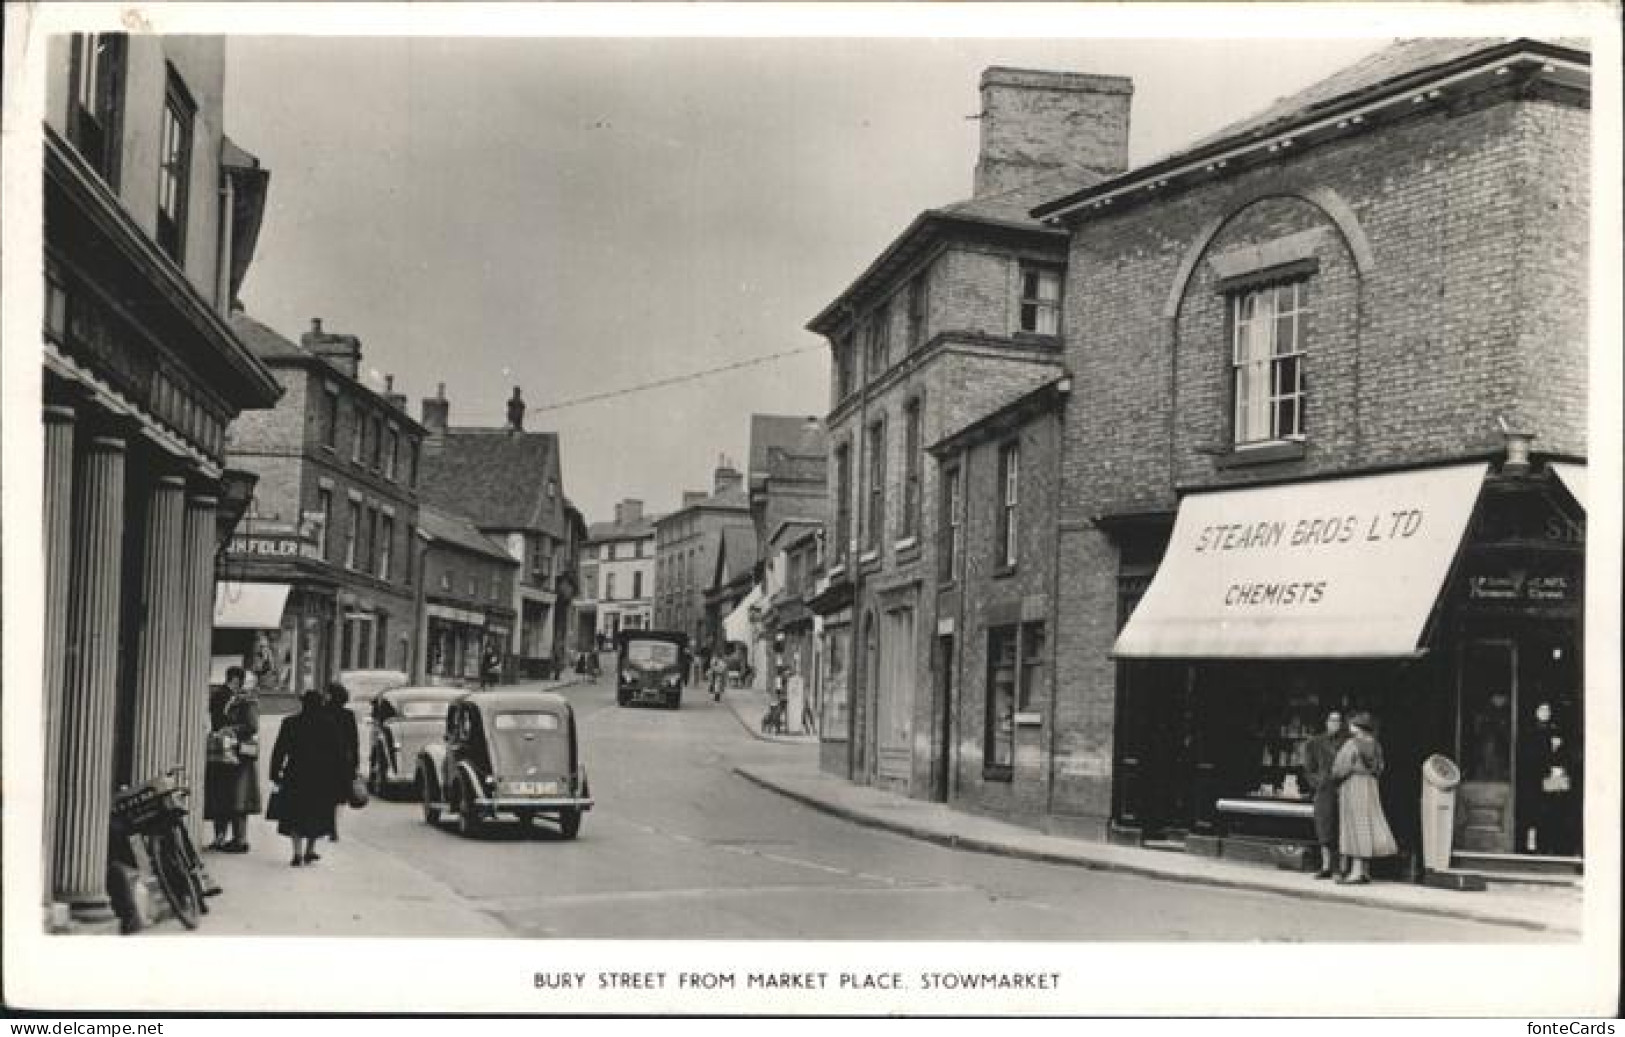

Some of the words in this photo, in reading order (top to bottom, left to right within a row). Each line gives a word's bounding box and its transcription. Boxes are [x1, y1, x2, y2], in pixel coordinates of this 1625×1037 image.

[1195, 520, 1287, 552] STEARN
[1290, 514, 1359, 547] BROS
[1366, 508, 1424, 541] LTD
[1223, 581, 1327, 606] CHEMISTS
